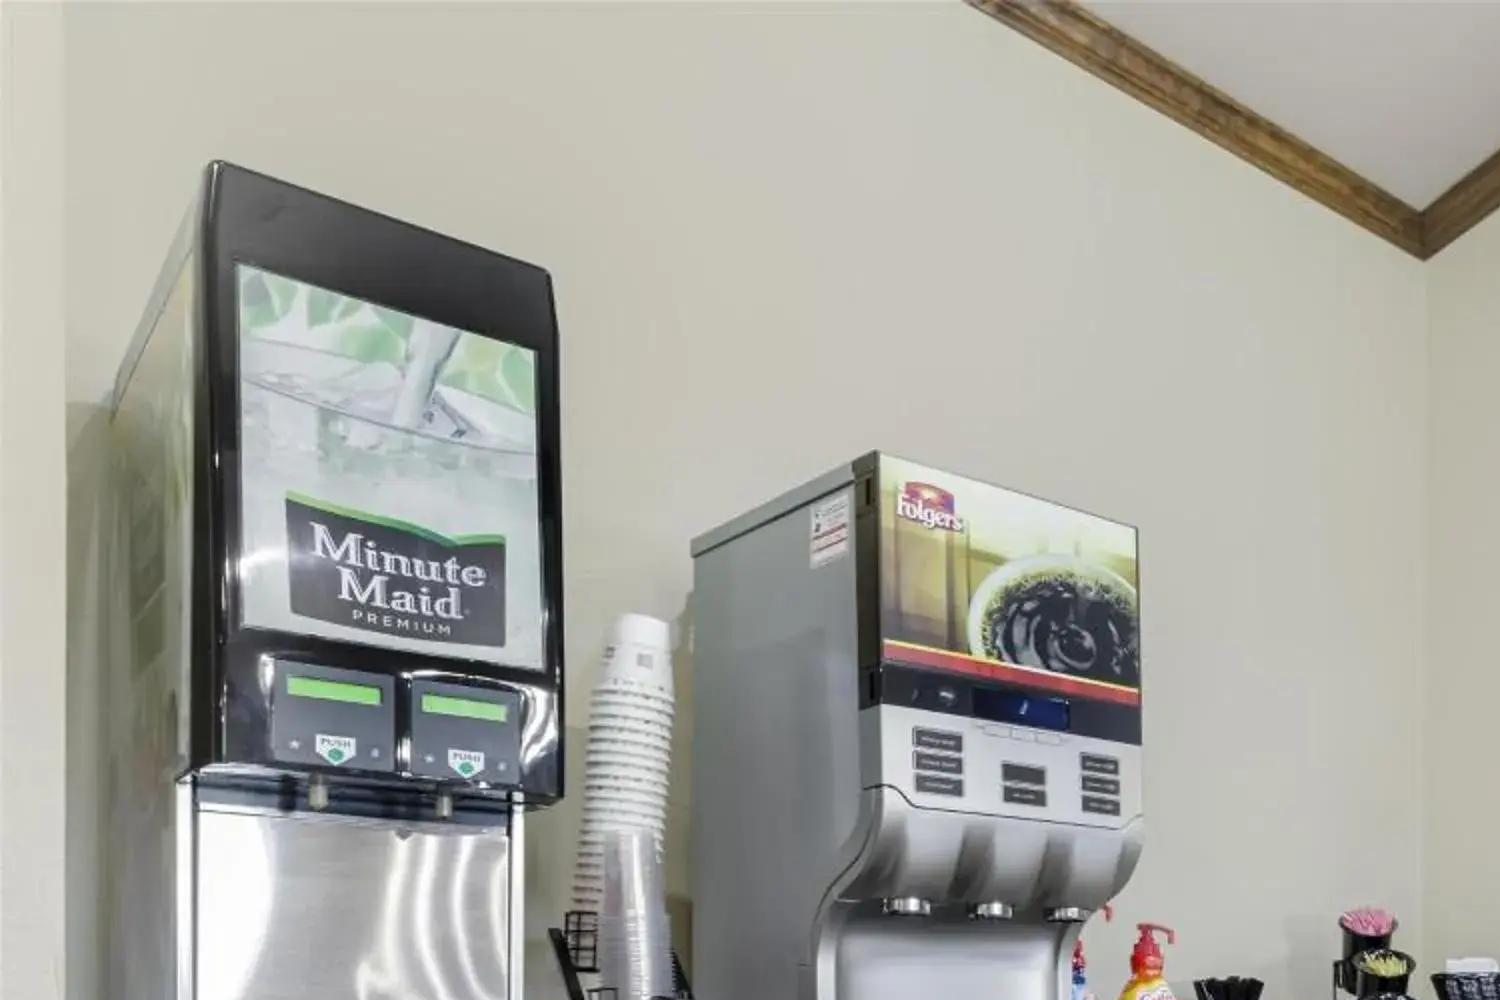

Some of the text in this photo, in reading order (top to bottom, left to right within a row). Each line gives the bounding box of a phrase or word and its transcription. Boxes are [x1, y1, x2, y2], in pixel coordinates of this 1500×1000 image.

[896, 491, 962, 531] Folgers
[309, 521, 487, 588] Minute
[337, 565, 464, 620] Maid
[352, 610, 452, 635] PREMIUM
[320, 737, 351, 748] PUSH
[452, 752, 481, 763] PUSH
